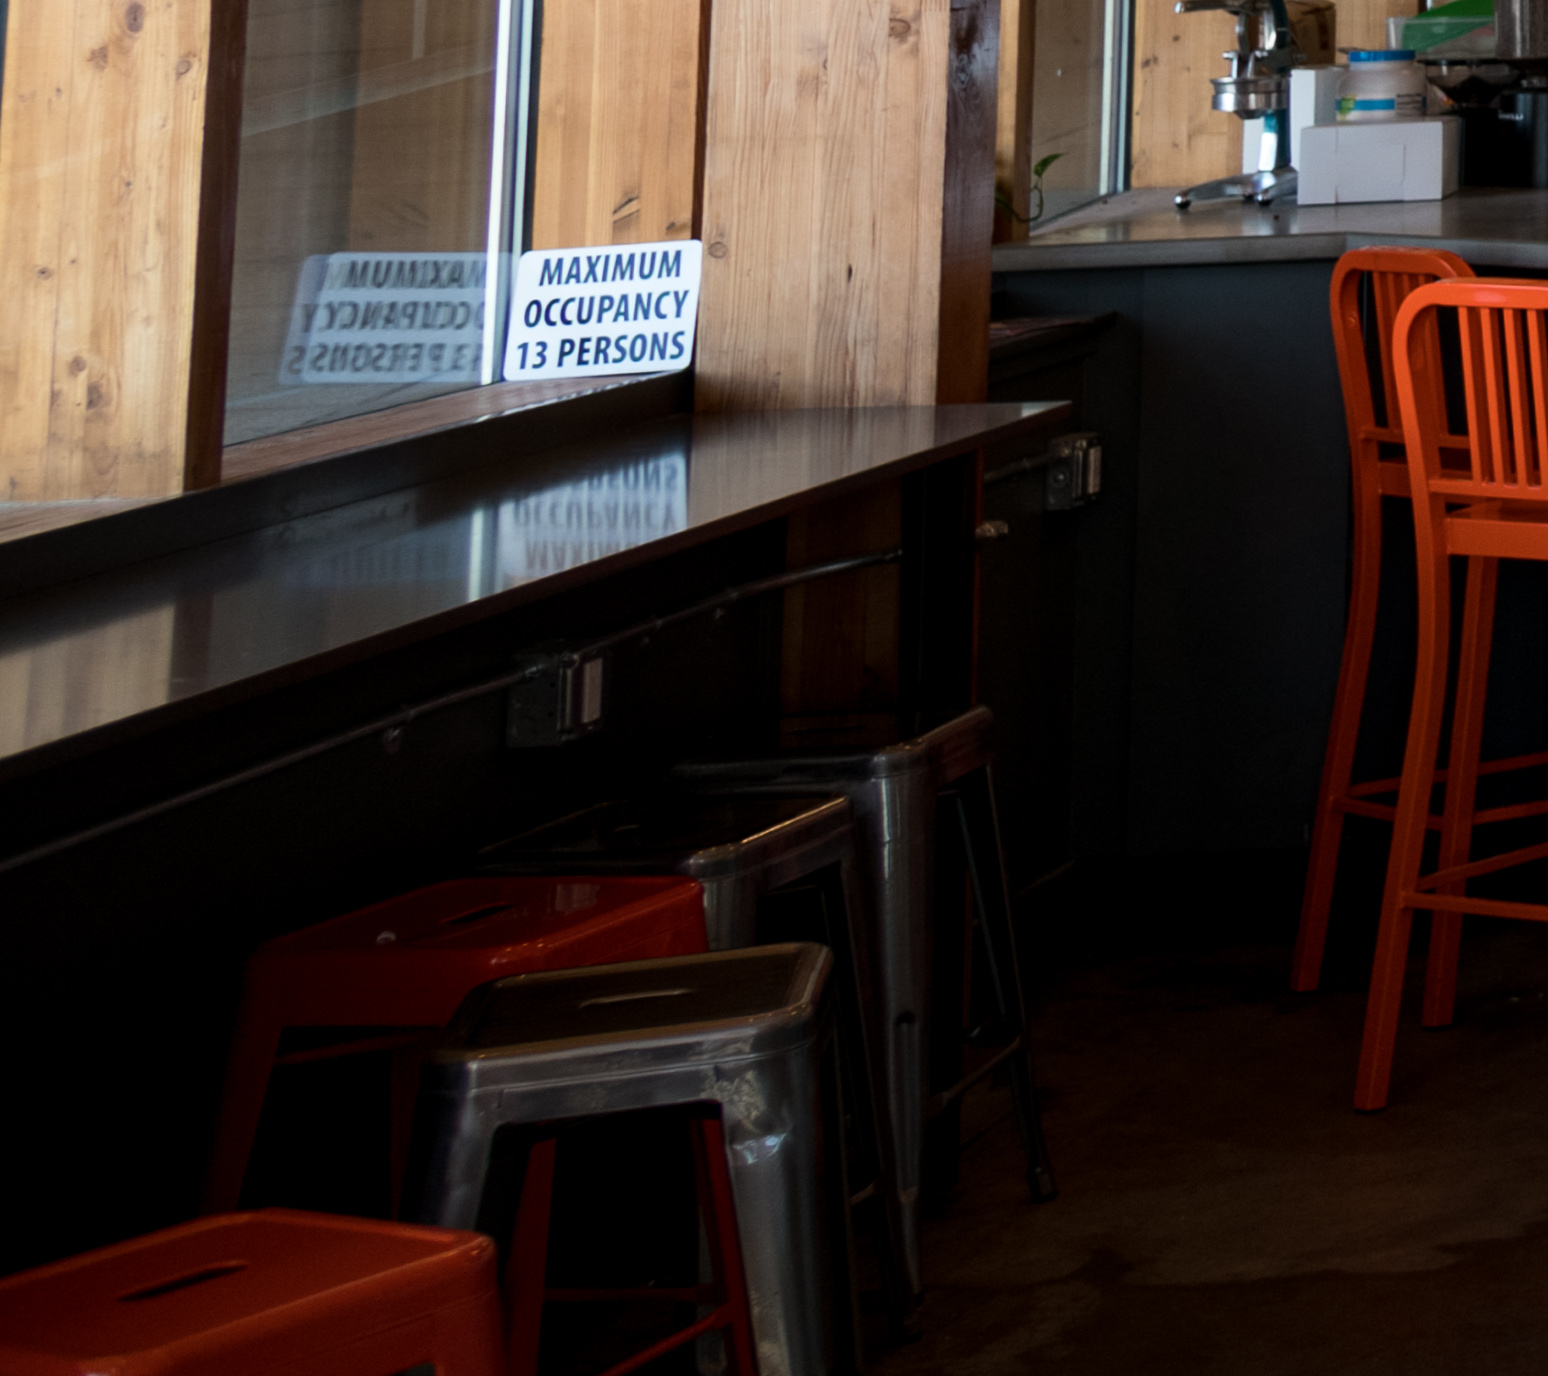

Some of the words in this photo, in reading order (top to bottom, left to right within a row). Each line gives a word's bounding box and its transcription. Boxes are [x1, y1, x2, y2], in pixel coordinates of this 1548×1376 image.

[538, 249, 684, 288] MAXIMUM
[524, 289, 689, 328] OCCUPANCY
[515, 341, 549, 370] 13
[557, 330, 686, 367] PERSONS
